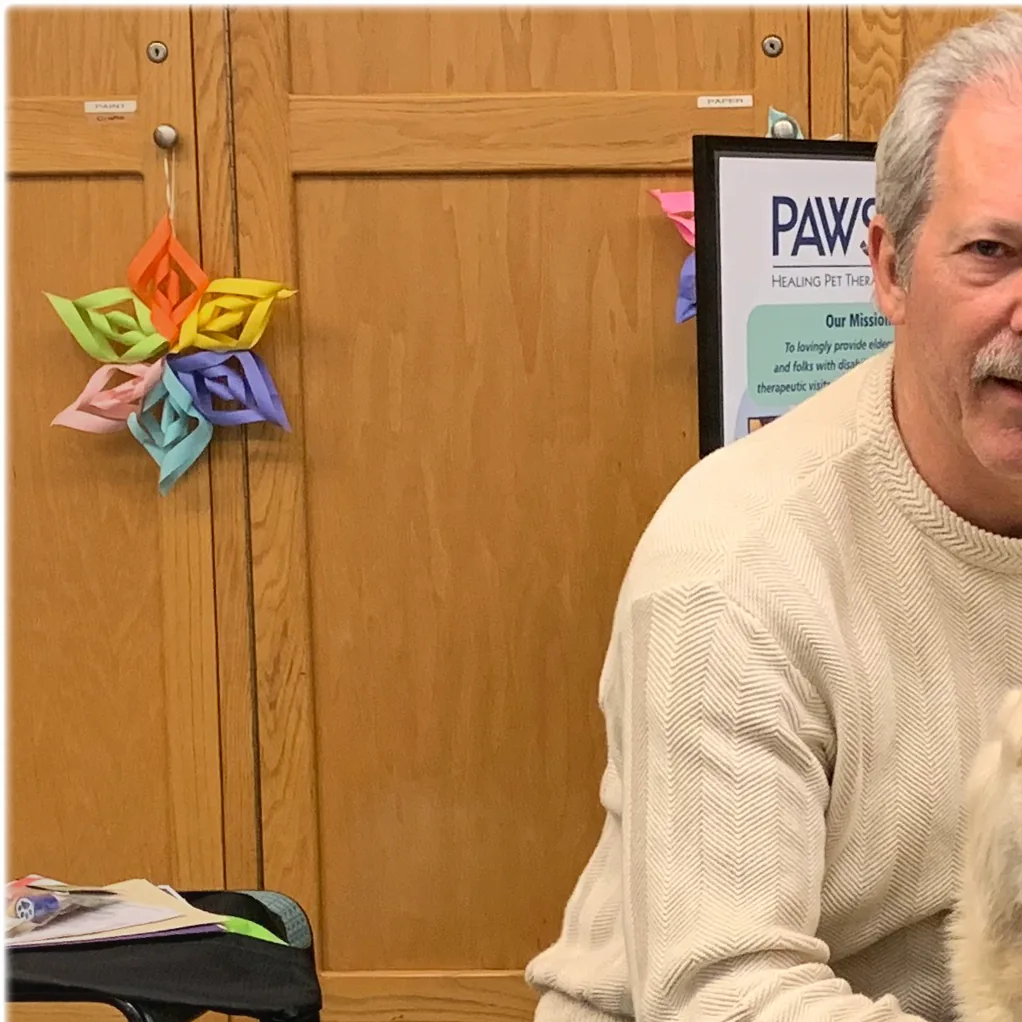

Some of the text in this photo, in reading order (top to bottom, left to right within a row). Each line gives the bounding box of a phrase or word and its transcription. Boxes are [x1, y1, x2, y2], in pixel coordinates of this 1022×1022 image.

[772, 273, 821, 288] HEALING
[825, 273, 842, 287] PET
[826, 313, 846, 328] Our
[785, 342, 795, 353] To
[797, 340, 832, 354] lovingly
[833, 339, 867, 353] provide
[773, 362, 791, 373] and
[793, 361, 813, 373] folks
[816, 360, 836, 372] with
[757, 382, 806, 395] therapeutic
